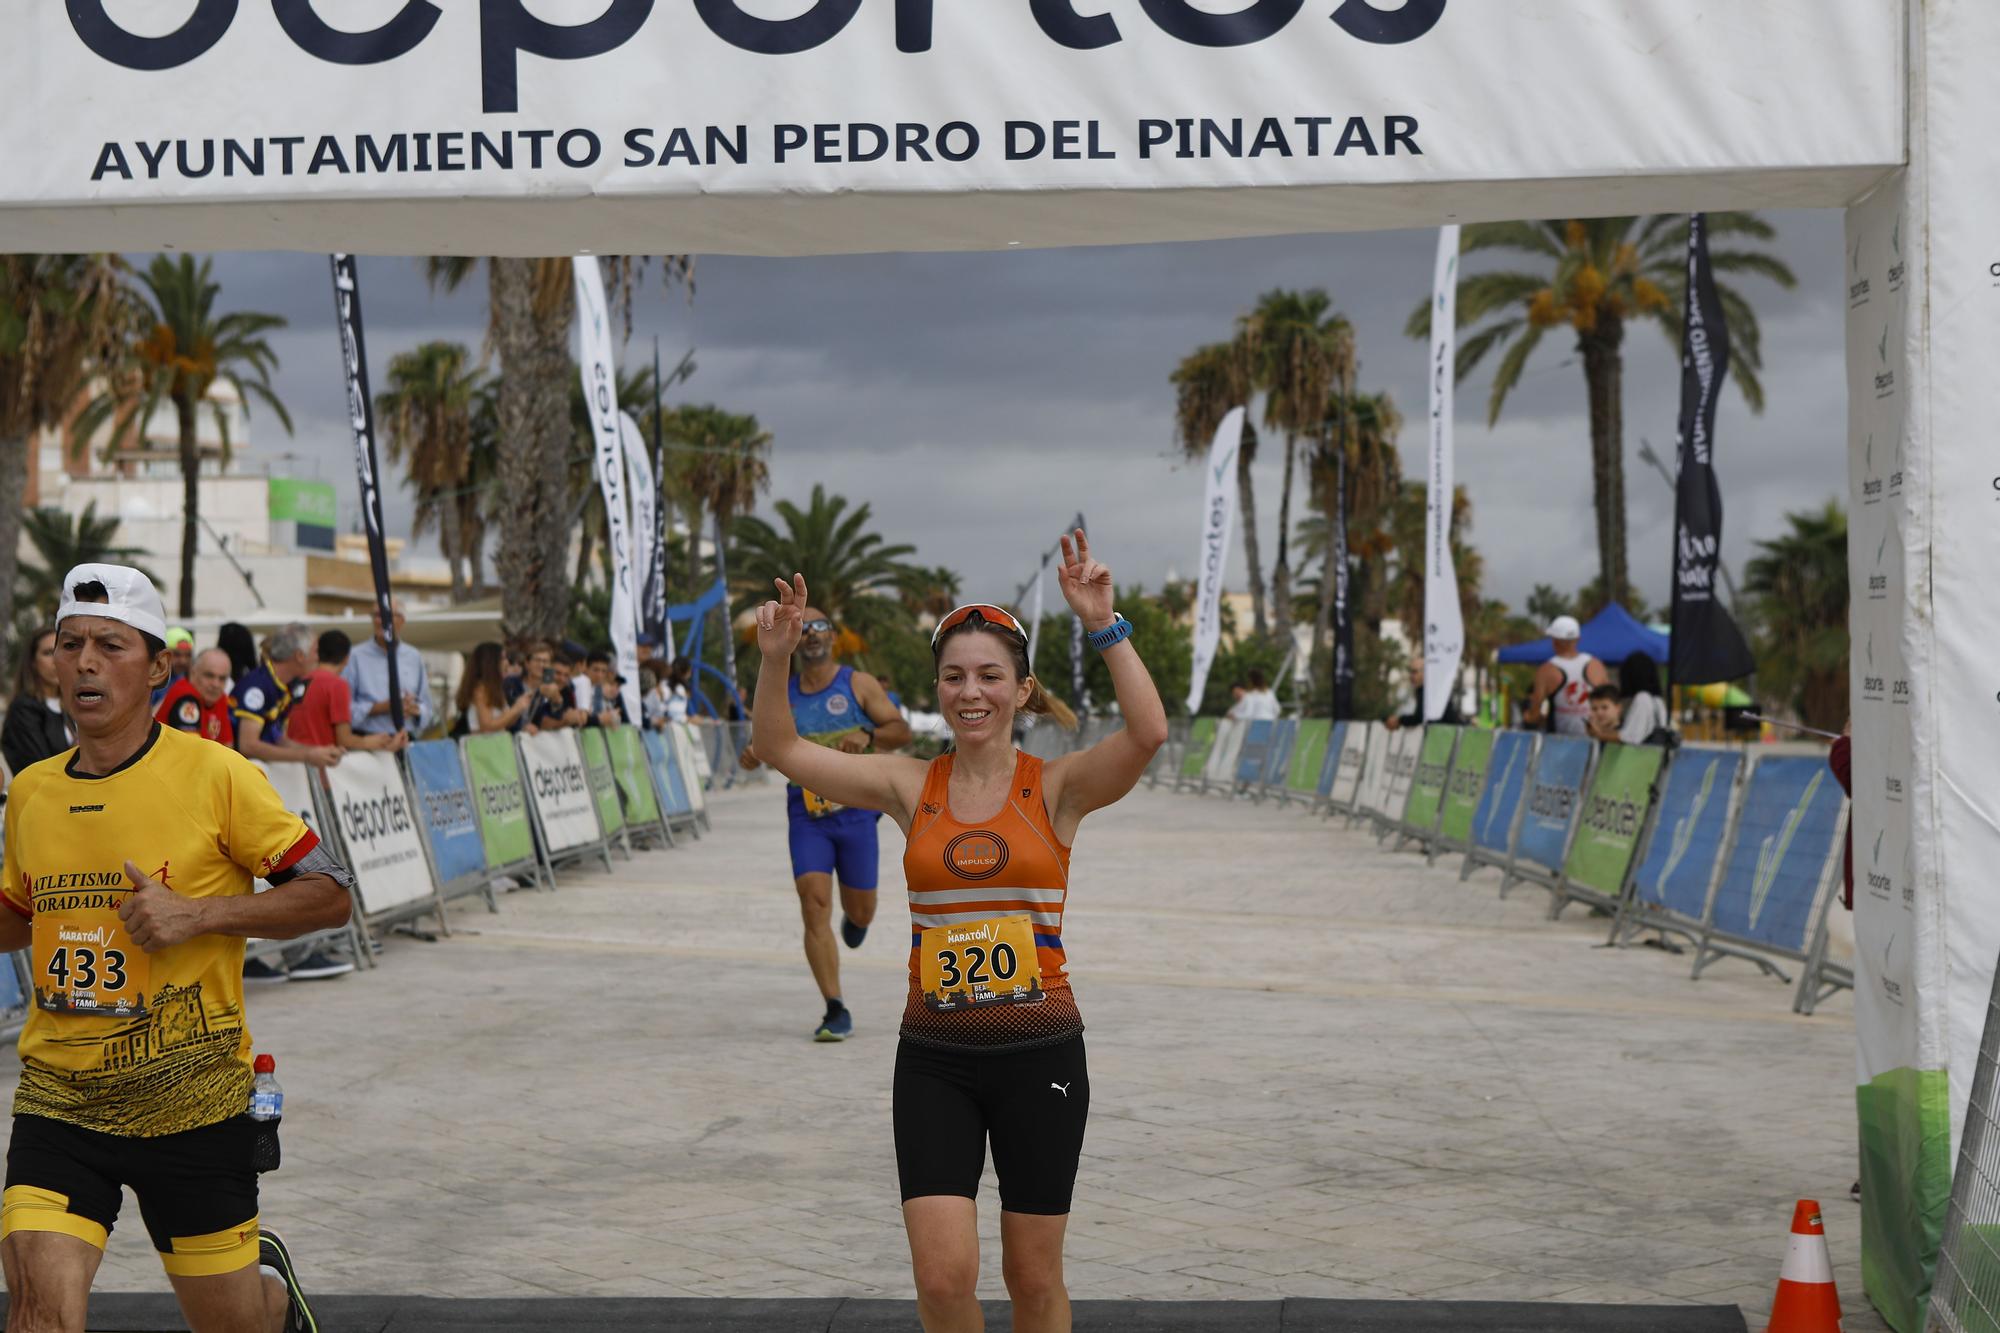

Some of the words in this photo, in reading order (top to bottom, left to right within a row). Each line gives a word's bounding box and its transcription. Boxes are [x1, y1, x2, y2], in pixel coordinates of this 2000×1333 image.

[91, 127, 602, 181] AYUNTAMIENTO
[624, 124, 748, 168] SAN
[773, 120, 980, 165] PEDRO
[1004, 119, 1116, 162] DEL
[1138, 114, 1424, 159] PINATAR
[342, 784, 411, 852] deportes
[957, 858, 997, 866] IMPULSO
[32, 872, 123, 894] ATLETISMO
[59, 930, 101, 942] MARATÓN
[948, 929, 988, 944] MARATÓN
[47, 946, 128, 992] 433
[937, 941, 1018, 989] 320
[75, 999, 98, 1009] FAMU
[975, 991, 997, 1001] FAMU
